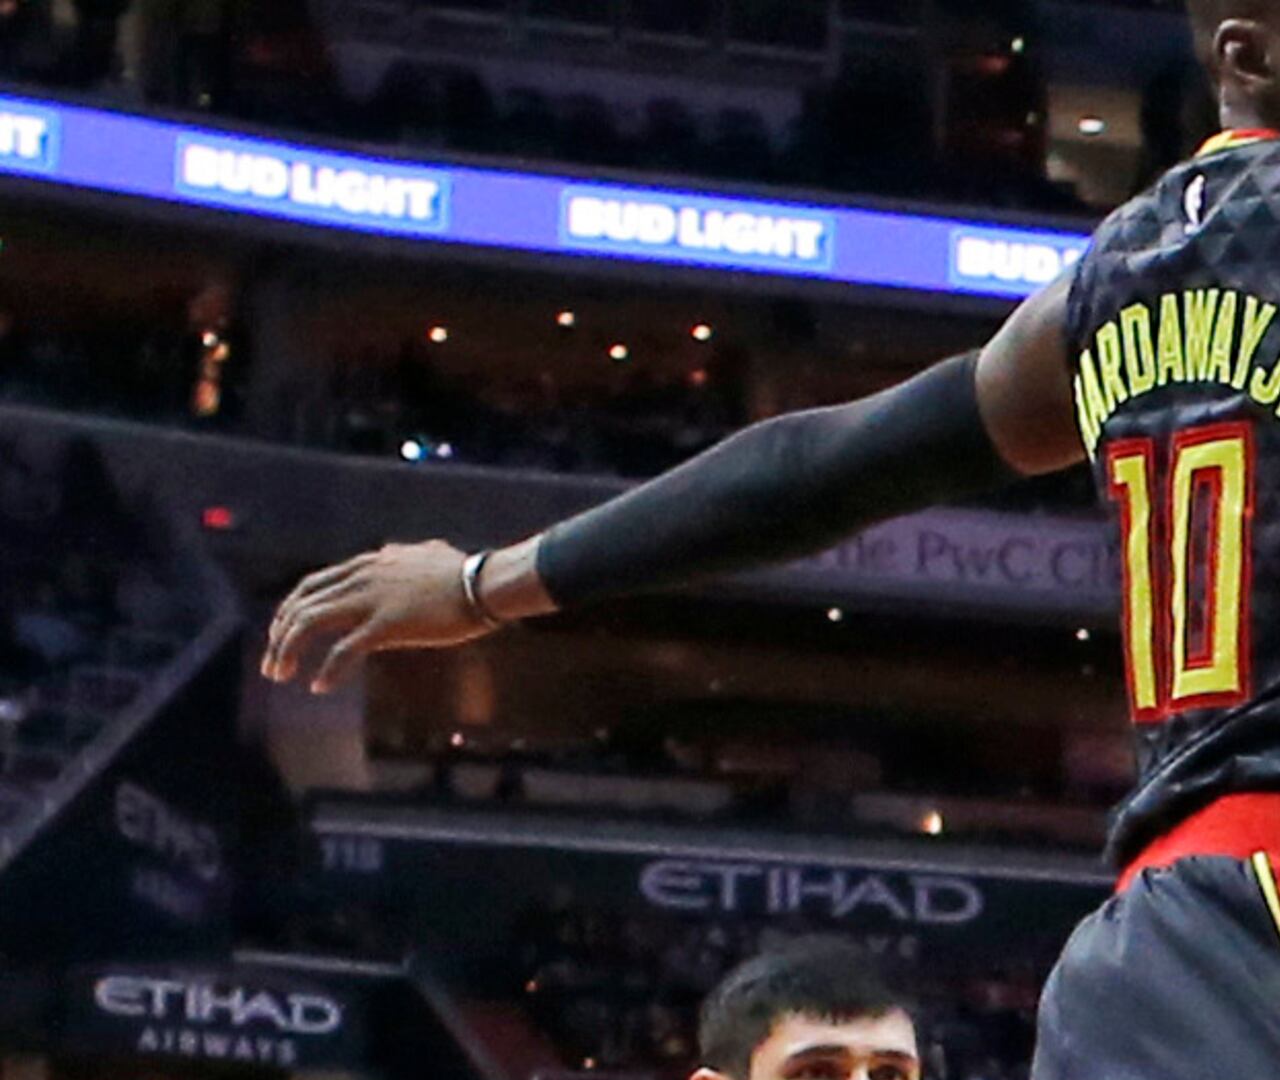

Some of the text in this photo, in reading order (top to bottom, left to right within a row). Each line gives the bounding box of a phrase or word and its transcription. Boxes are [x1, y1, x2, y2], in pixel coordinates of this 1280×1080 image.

[183, 144, 440, 220] BUD LIGHT
[567, 196, 823, 258] BUD LIGHT
[956, 236, 1060, 284] BUD
[1106, 422, 1254, 720] 10
[639, 857, 984, 924] ETIHAD
[94, 974, 344, 1035] ETIHAD
